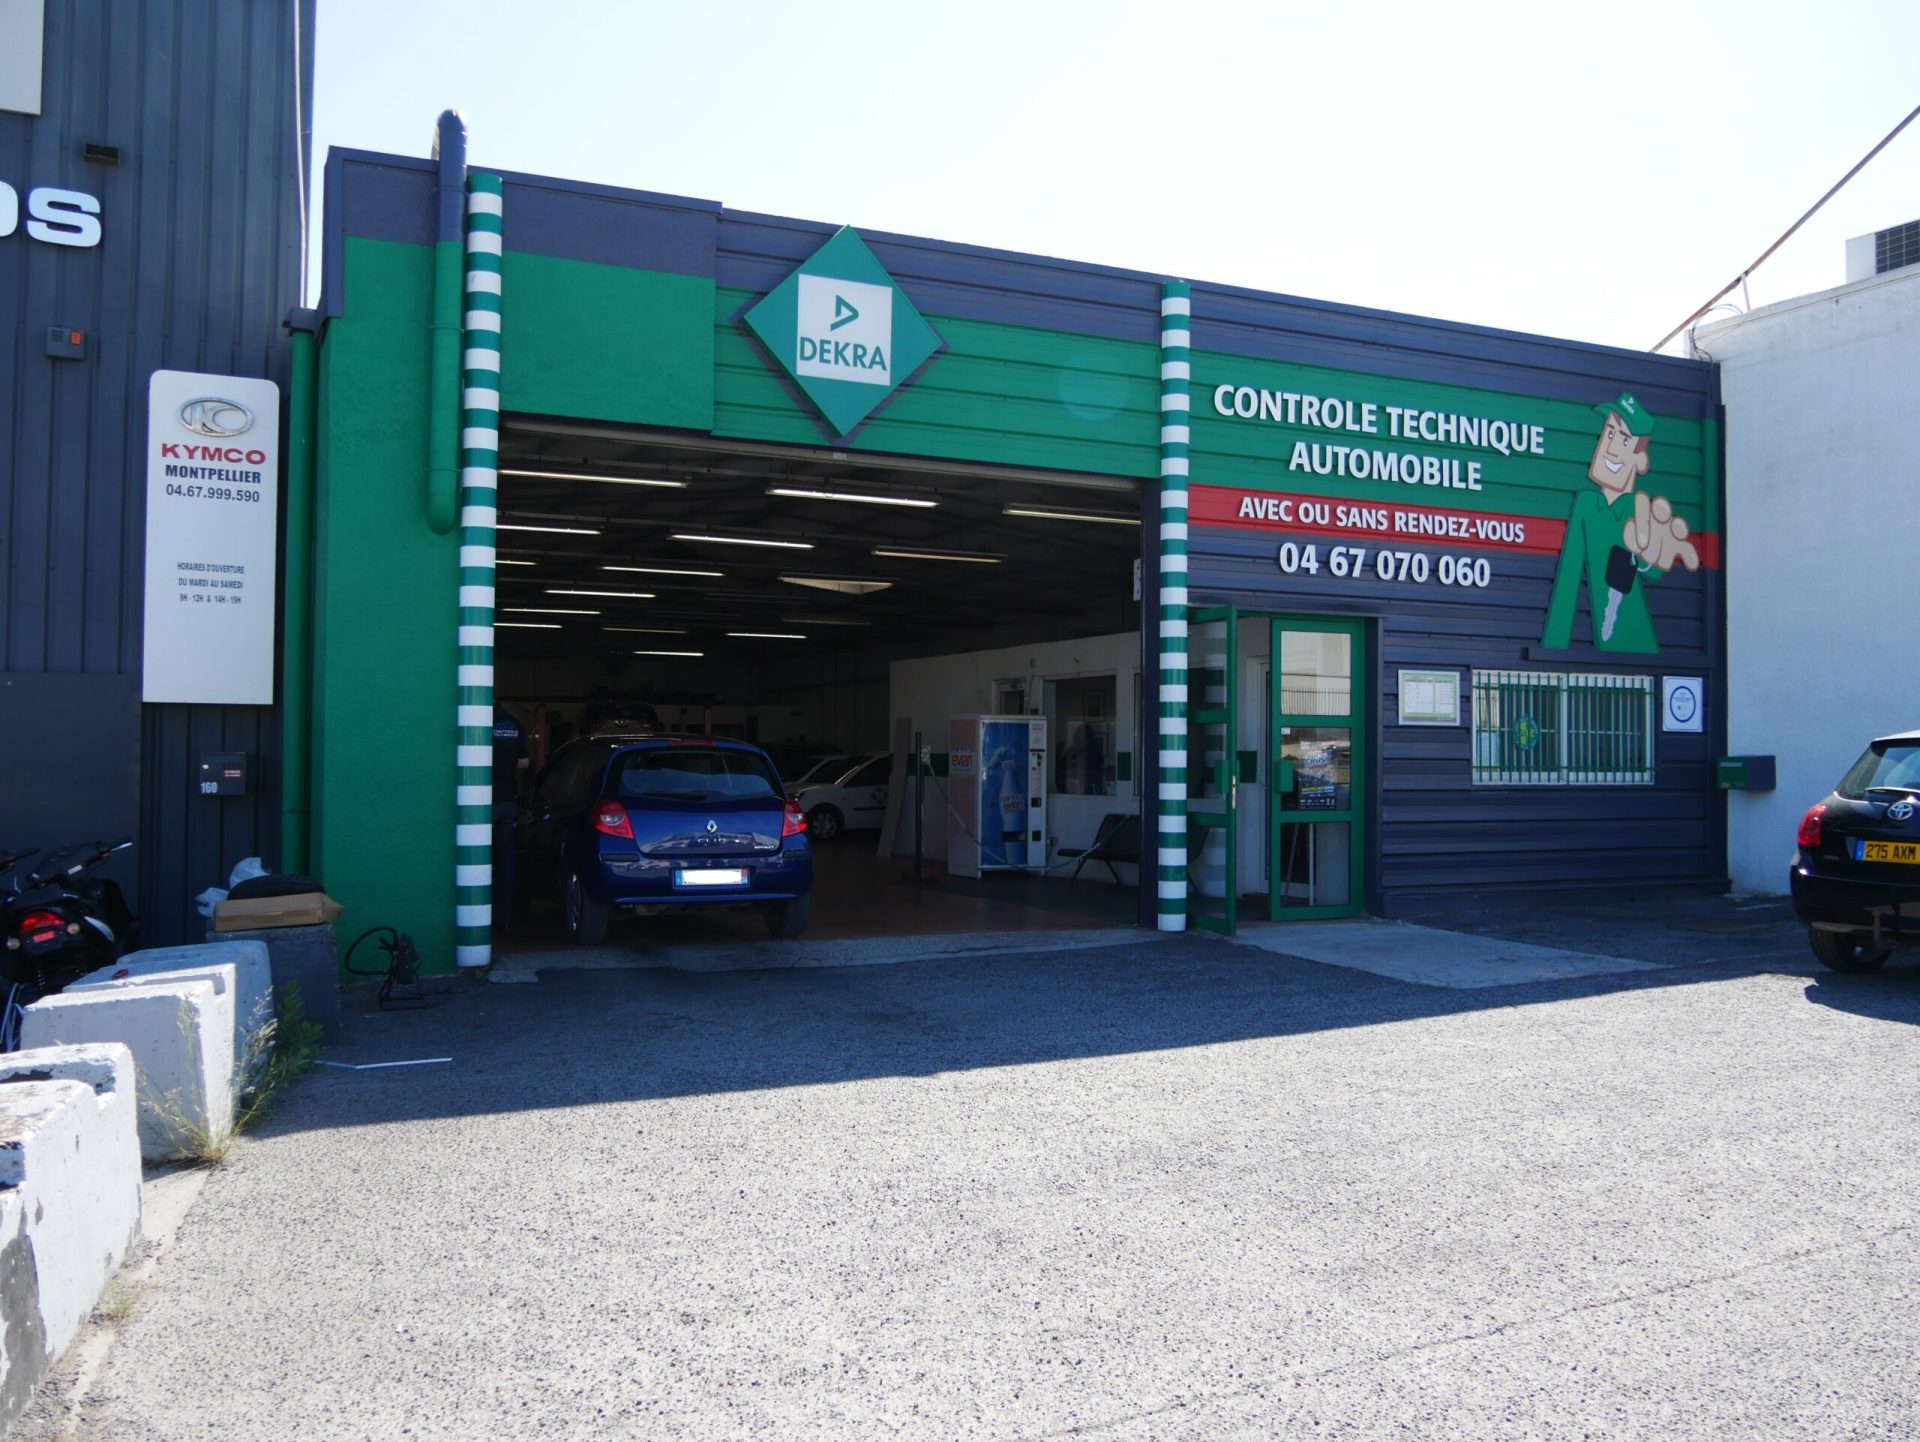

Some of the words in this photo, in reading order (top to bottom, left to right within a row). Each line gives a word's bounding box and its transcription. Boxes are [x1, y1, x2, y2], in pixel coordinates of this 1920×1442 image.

[799, 336, 888, 371] DEKRA
[1214, 384, 1378, 433] CONTROLE
[1385, 406, 1545, 456] TECHNIQUE
[161, 443, 266, 465] KYMCO
[165, 464, 262, 484] MONTPELLIER
[1288, 441, 1482, 491] AUTOMOBILE
[166, 483, 260, 503] 04.67.999.590
[1239, 496, 1294, 522] AVEC
[1298, 502, 1330, 525] OU
[1336, 506, 1389, 531] SANS
[1394, 511, 1525, 544] RENDEZ-VOUS
[177, 562, 205, 572] HORAIRES
[206, 564, 245, 574] D'OUVERTURE
[1279, 542, 1319, 575] 04
[1329, 546, 1366, 577] 67
[1376, 550, 1429, 583] 070
[1438, 555, 1491, 588] 060
[178, 577, 187, 586] DU
[188, 578, 209, 587] MARDI
[210, 579, 219, 588] AU
[220, 580, 244, 589] SAMEDI
[200, 781, 218, 794] 160
[1866, 843, 1889, 859] 275
[1892, 845, 1917, 861] AXM
